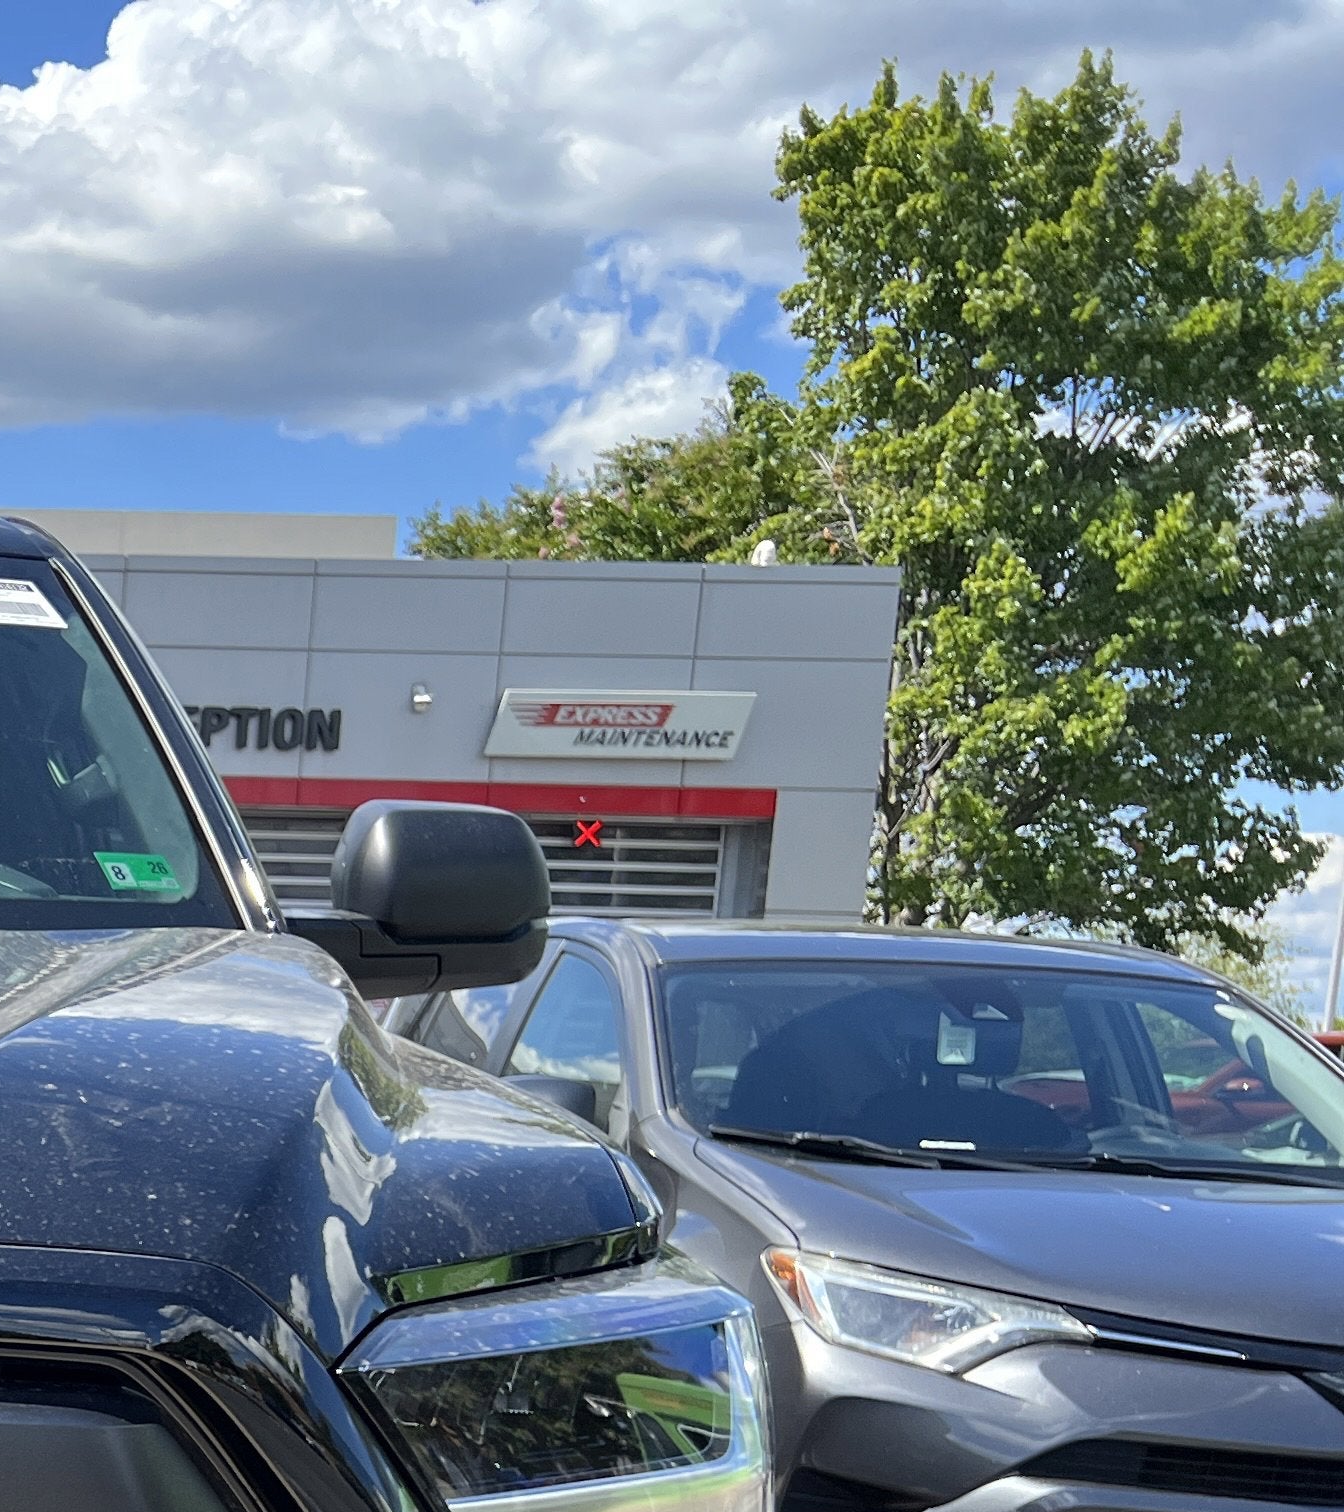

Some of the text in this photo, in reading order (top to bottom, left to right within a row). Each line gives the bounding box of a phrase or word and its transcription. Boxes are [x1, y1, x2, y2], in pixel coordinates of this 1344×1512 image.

[553, 705, 662, 726] EXPRESS
[573, 728, 735, 749] MAINTENANCE
[112, 865, 126, 880] 8
